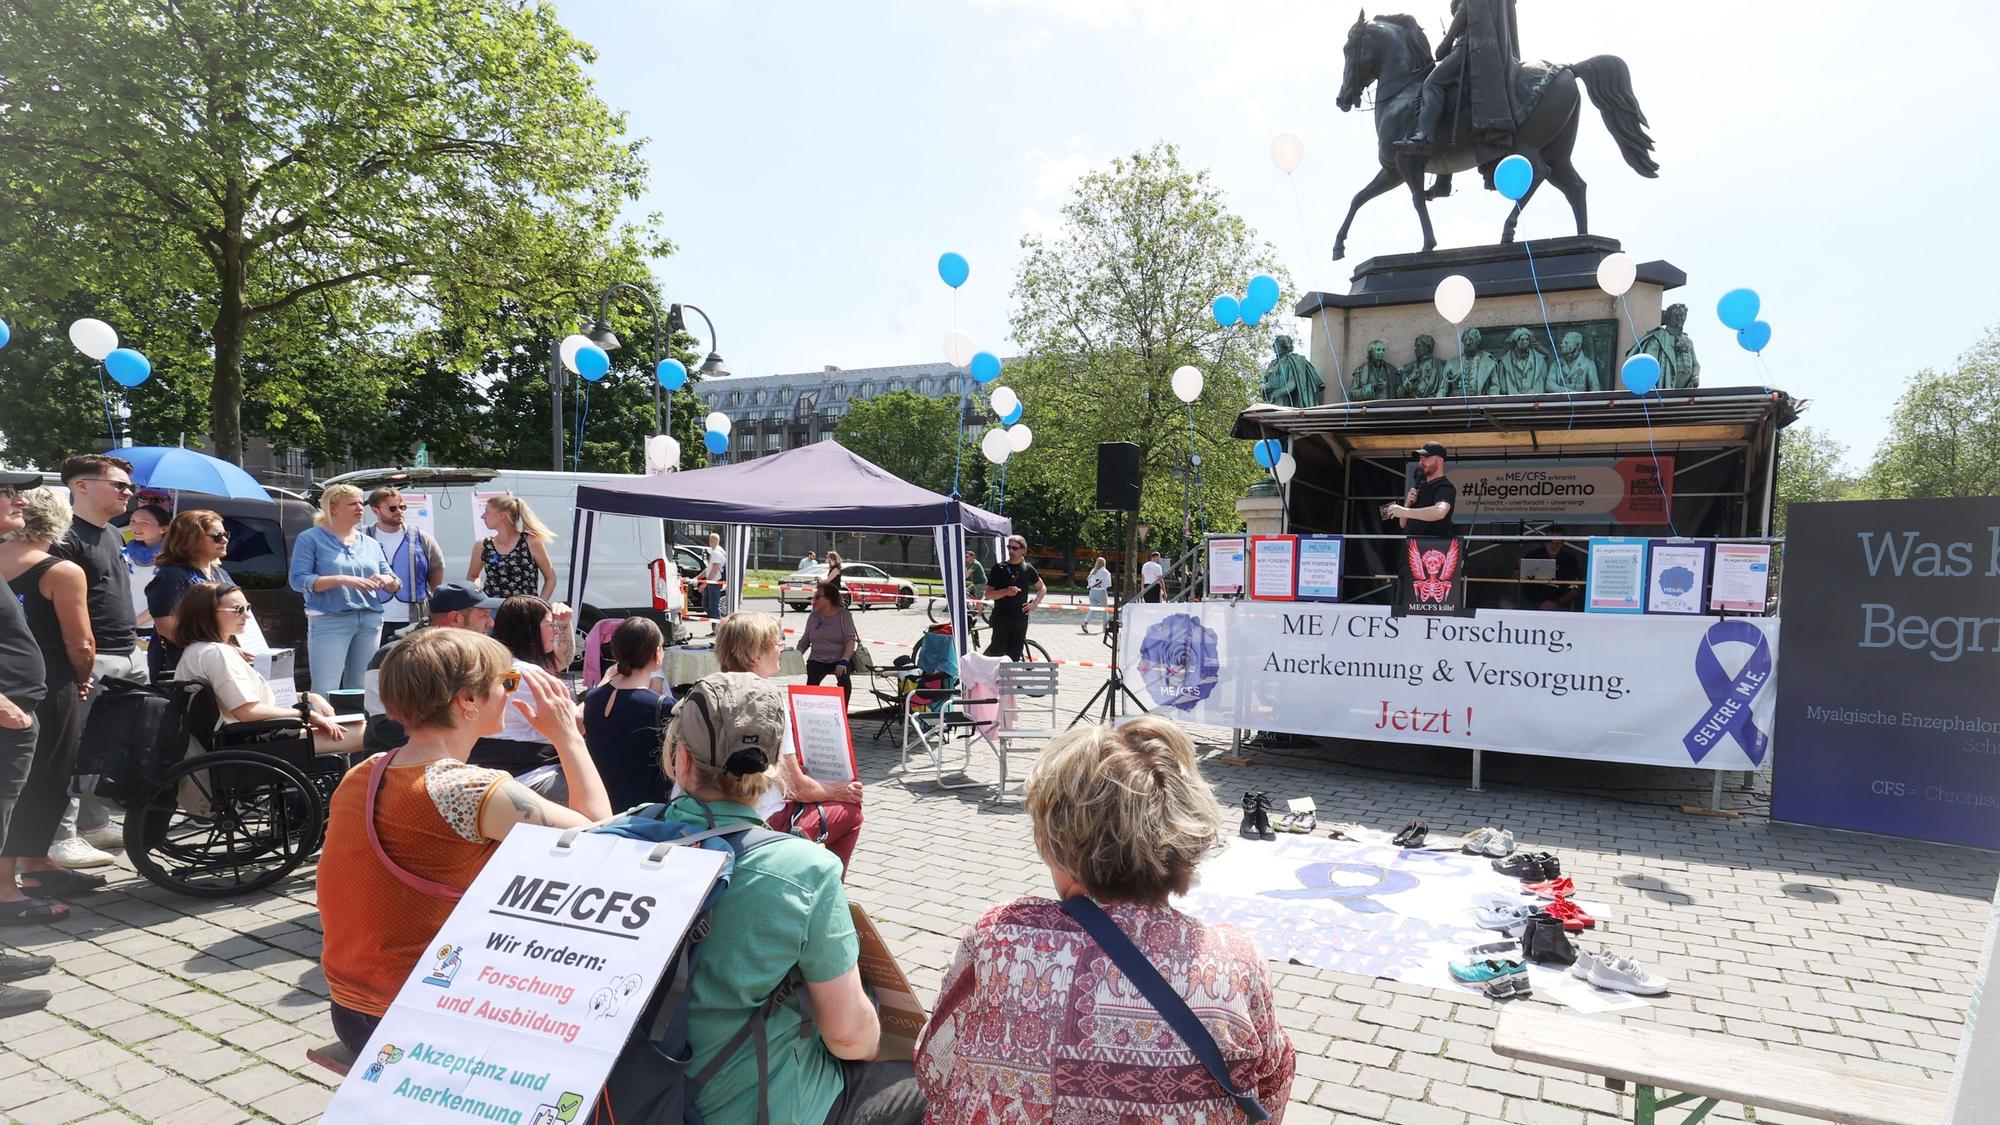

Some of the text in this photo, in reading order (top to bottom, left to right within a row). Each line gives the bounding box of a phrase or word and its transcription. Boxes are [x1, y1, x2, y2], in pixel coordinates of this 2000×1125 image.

[1462, 481, 1595, 499] #LiegendDemo
[1505, 472, 1547, 481] ME/CFS
[1857, 531, 1973, 577] Was
[1409, 603, 1438, 611] ME/CFS
[1282, 614, 1399, 639] ME / CFS
[1424, 617, 1572, 652] Forschung,
[1160, 686, 1200, 697] ME/CFS
[1263, 651, 1631, 699] Anerkennung & Versorgung.
[1375, 700, 1473, 736] Jetzt !
[1693, 698, 1742, 746] SEVERE
[1807, 705, 1897, 725] Myalgische
[1871, 780, 1905, 797] CFS
[497, 874, 657, 930] ME/CFS
[485, 932, 607, 972] Wir fordern:
[476, 965, 576, 1005] Forschung
[436, 994, 582, 1044] und Ausbildung
[407, 1042, 551, 1092] Akzeptanz und
[393, 1076, 524, 1125] Anerkennung
